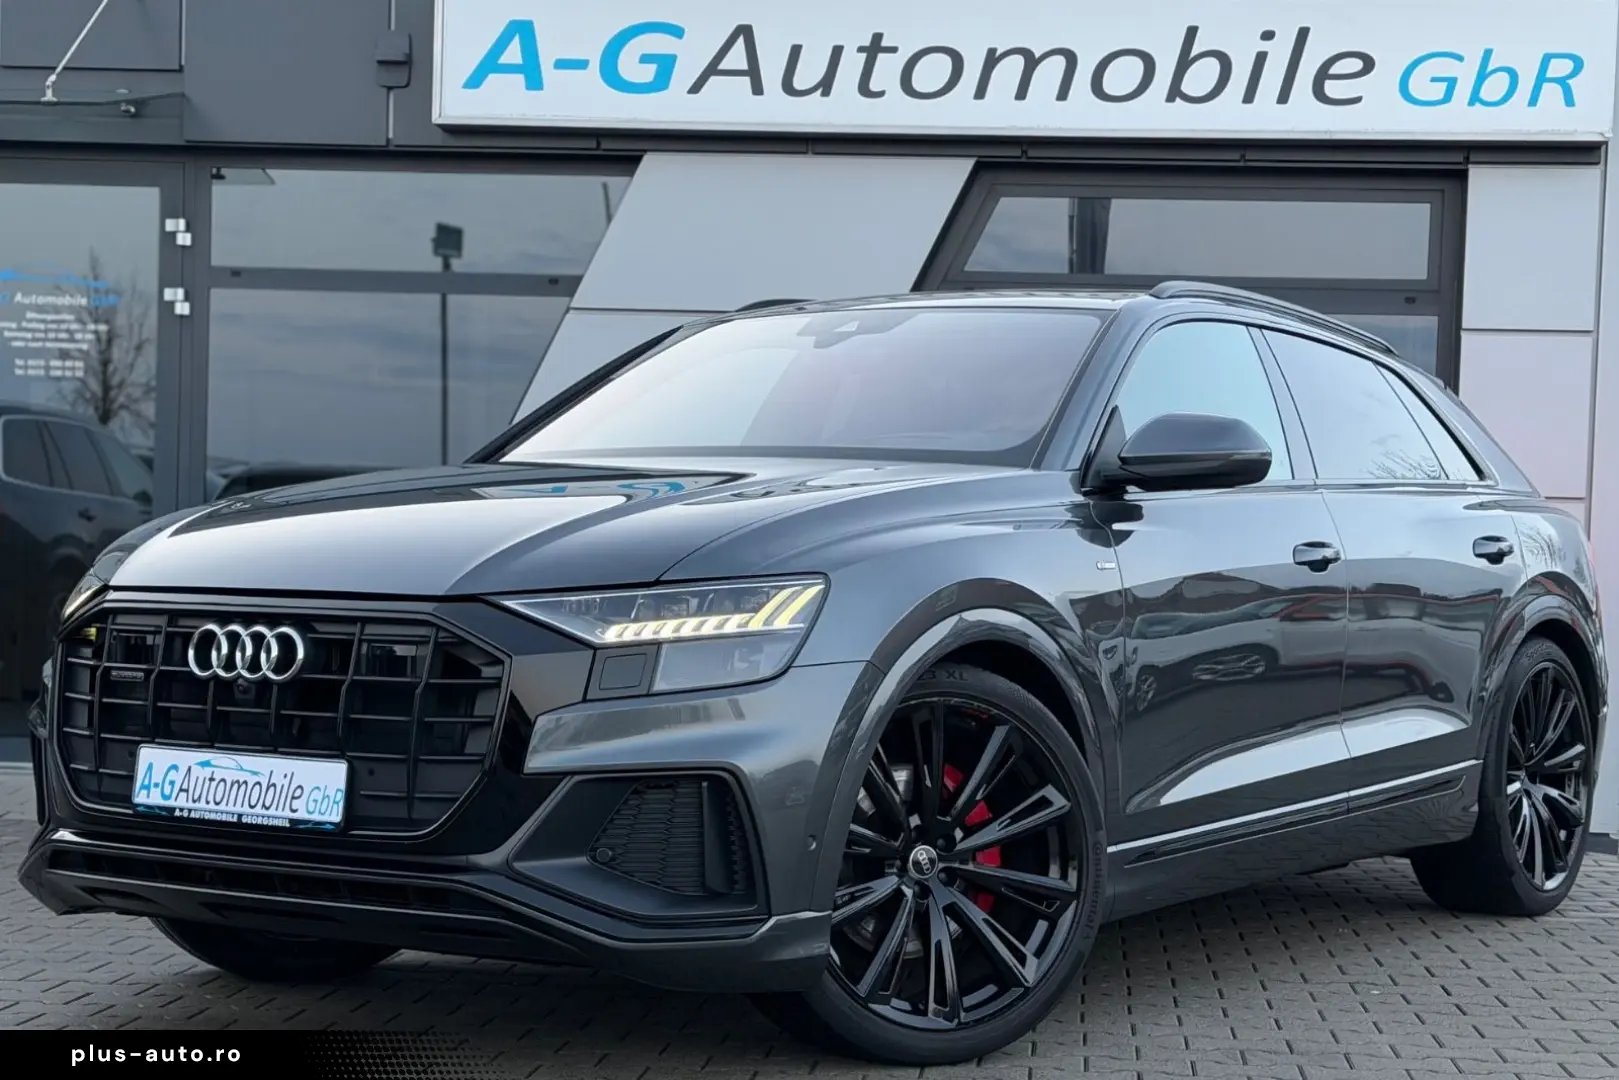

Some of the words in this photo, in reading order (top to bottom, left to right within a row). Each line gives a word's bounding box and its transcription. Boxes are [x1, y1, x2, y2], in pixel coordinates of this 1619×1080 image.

[1398, 47, 1585, 108] GbR
[13, 291, 88, 307] Automobile
[305, 784, 345, 817] GbR
[173, 808, 189, 818] A-G
[189, 809, 239, 822] AUTOMOBILE
[241, 814, 291, 828] GEORGSHEIL
